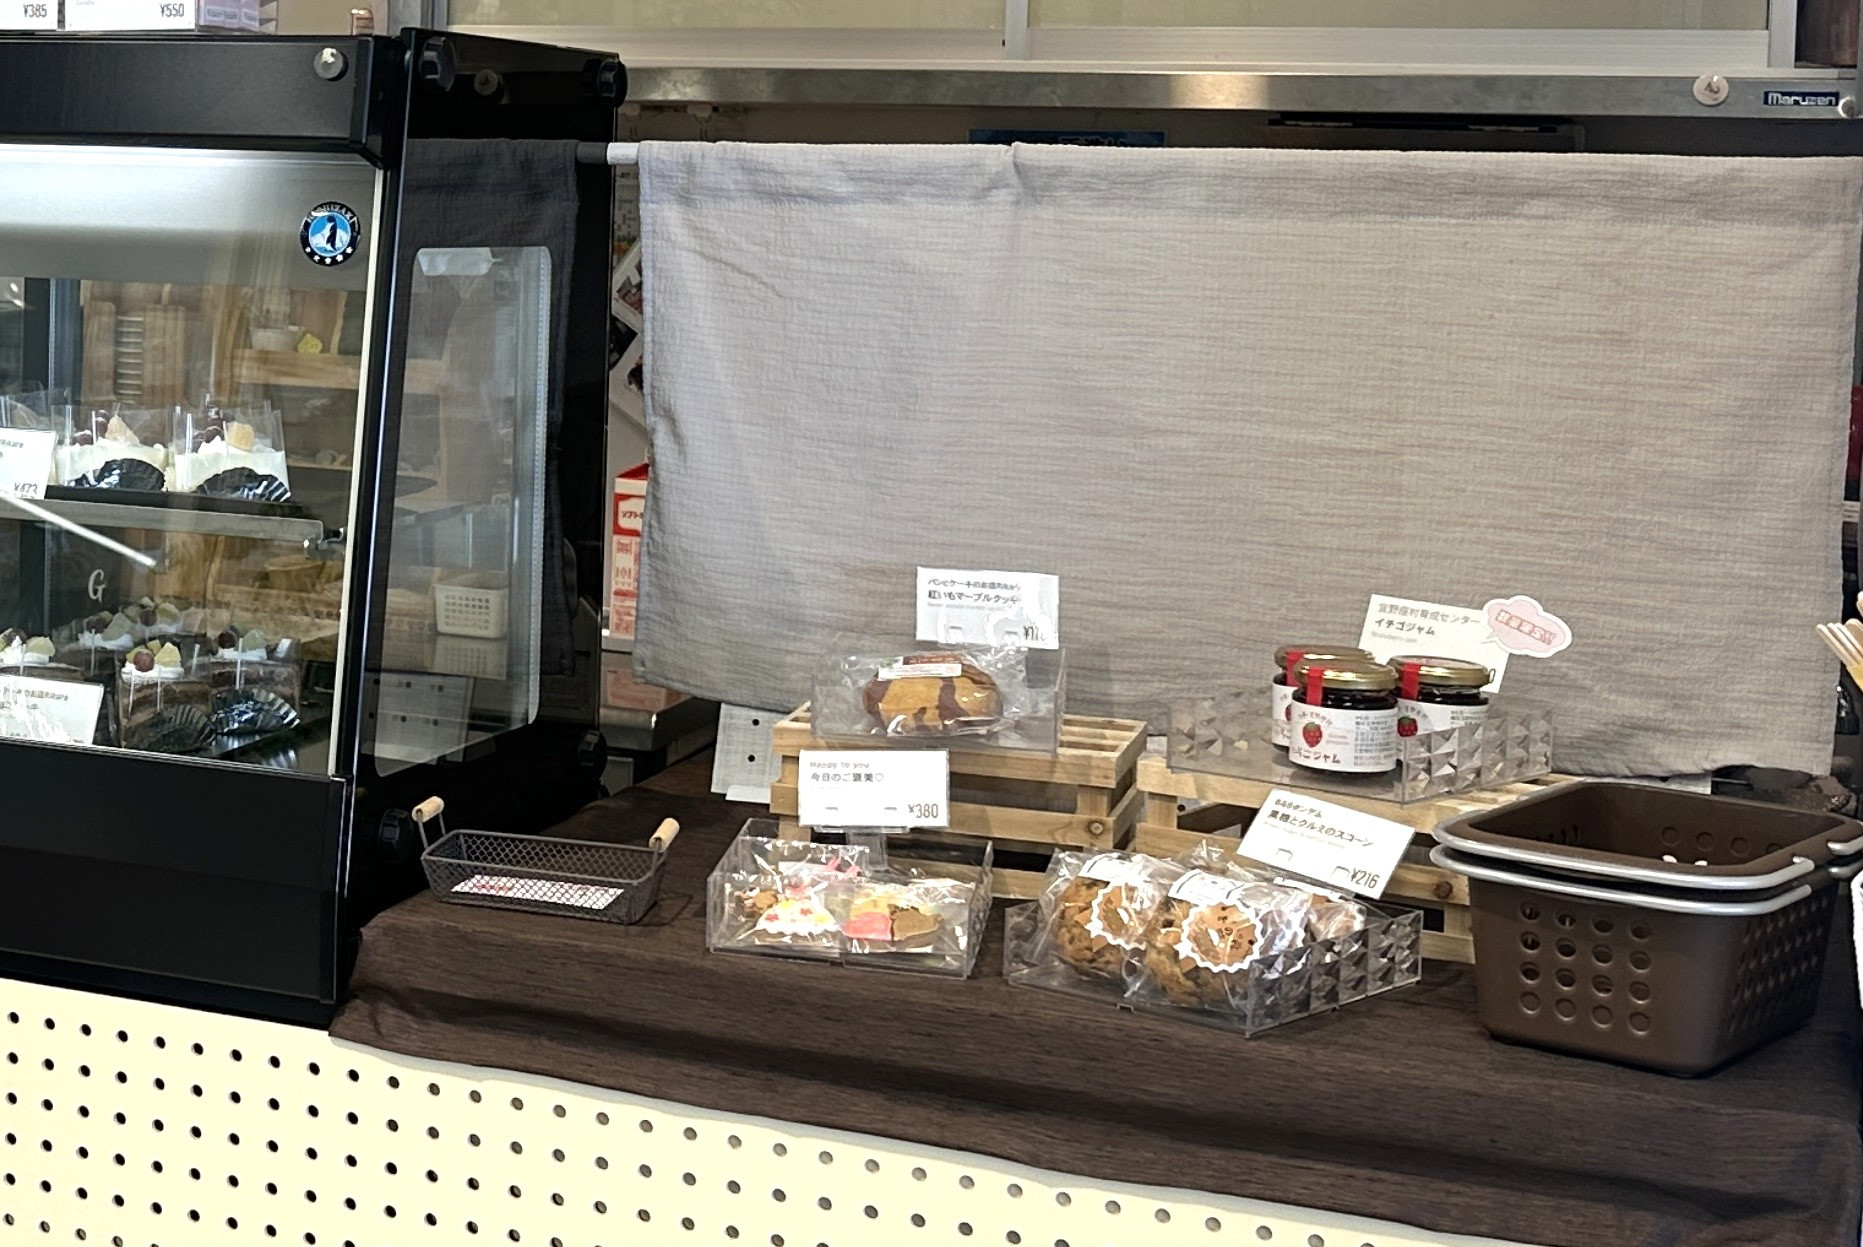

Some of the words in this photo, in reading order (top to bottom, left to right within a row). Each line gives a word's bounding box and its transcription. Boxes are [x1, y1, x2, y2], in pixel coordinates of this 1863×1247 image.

[23, 4, 48, 18] ¥385
[160, 4, 185, 18] ¥550
[1768, 92, 1836, 105] Maruzen
[1375, 618, 1435, 636] イチゴジャム
[908, 803, 939, 819] ¥380
[1267, 809, 1375, 847] 黒糖とクルミのスコーン
[1351, 867, 1380, 890] ¥216
